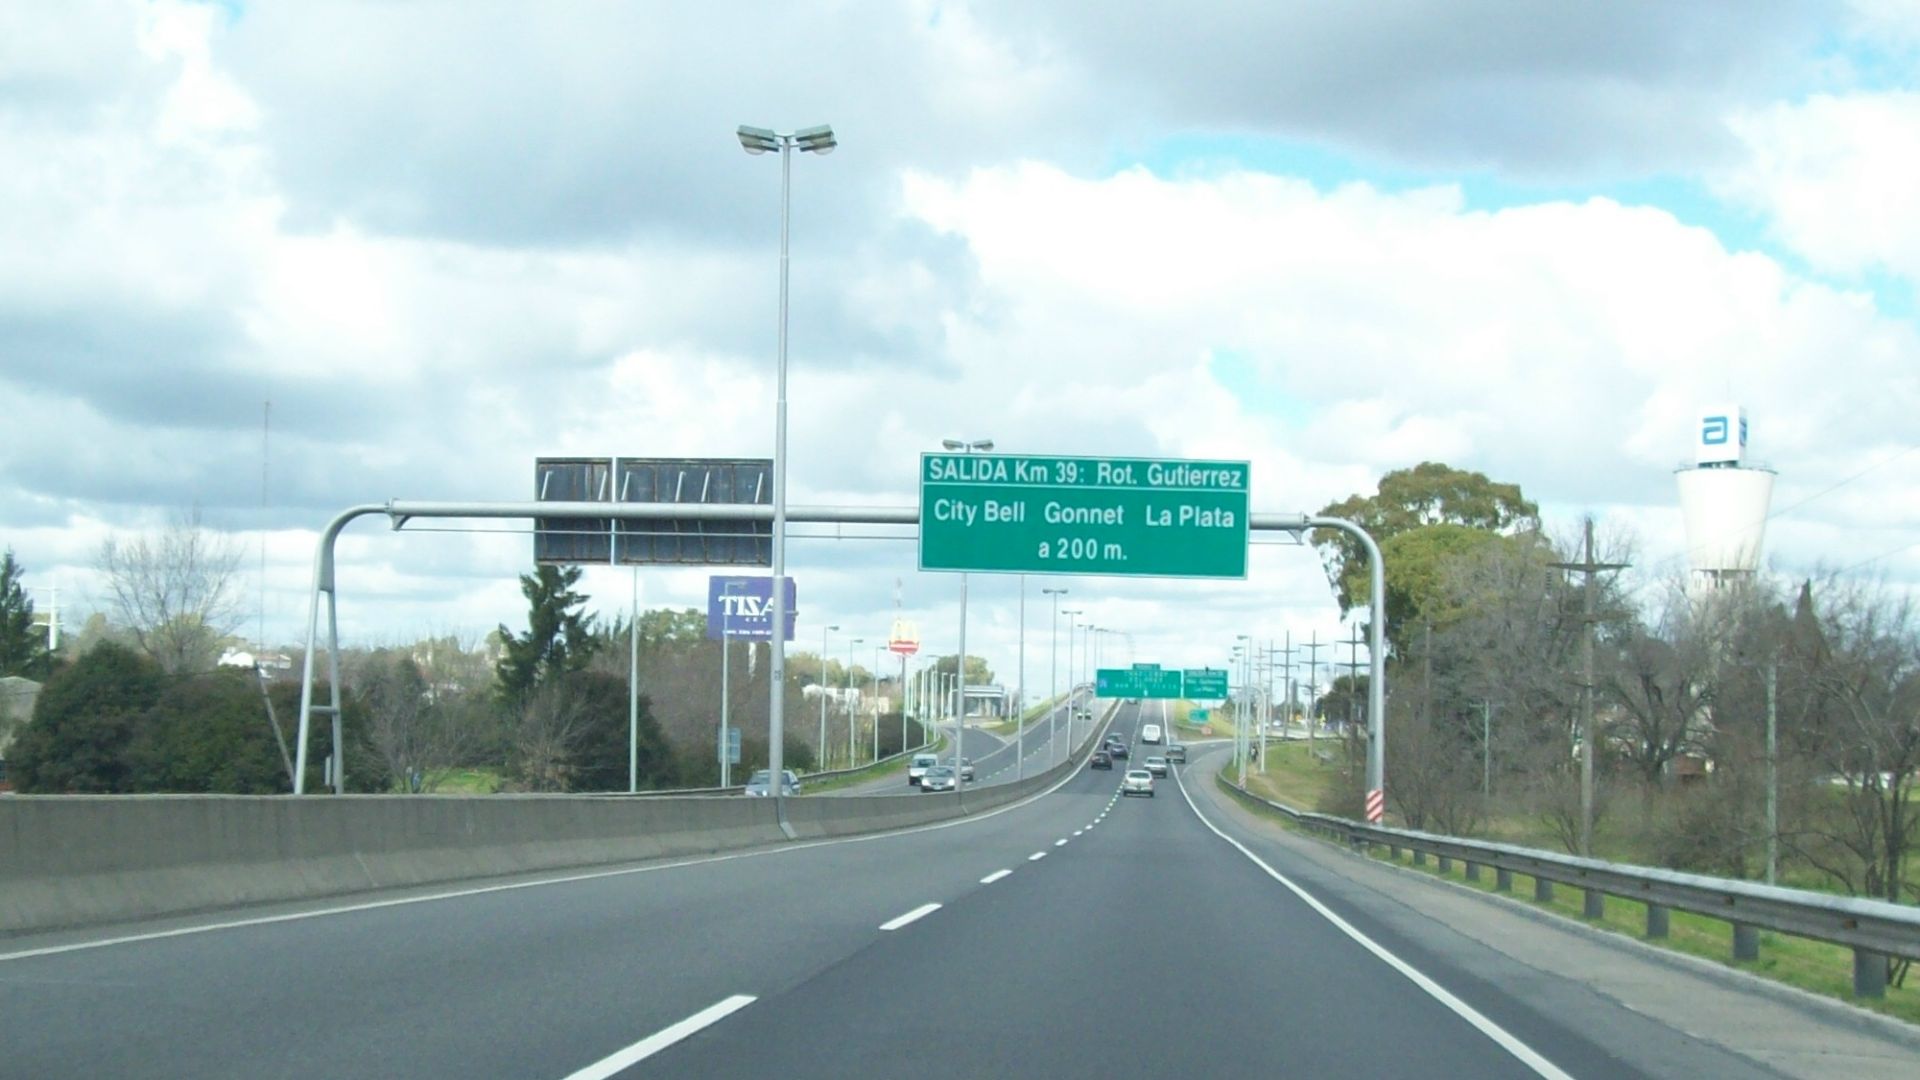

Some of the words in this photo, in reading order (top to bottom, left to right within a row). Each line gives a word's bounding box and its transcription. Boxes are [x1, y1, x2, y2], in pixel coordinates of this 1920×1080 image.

[929, 458, 1008, 482] SALIDA
[1015, 461, 1048, 483] Km
[1055, 462, 1085, 484] 39:
[1097, 463, 1138, 486] Rot.
[1147, 464, 1242, 488] Gutierrez
[934, 498, 977, 526] City
[984, 501, 1025, 522] Bell
[1044, 501, 1124, 525] Gonnet
[1146, 505, 1173, 527] La
[1179, 506, 1235, 528] Plata
[1038, 542, 1050, 559] a
[1057, 538, 1098, 560] 200
[1104, 542, 1128, 561] m.
